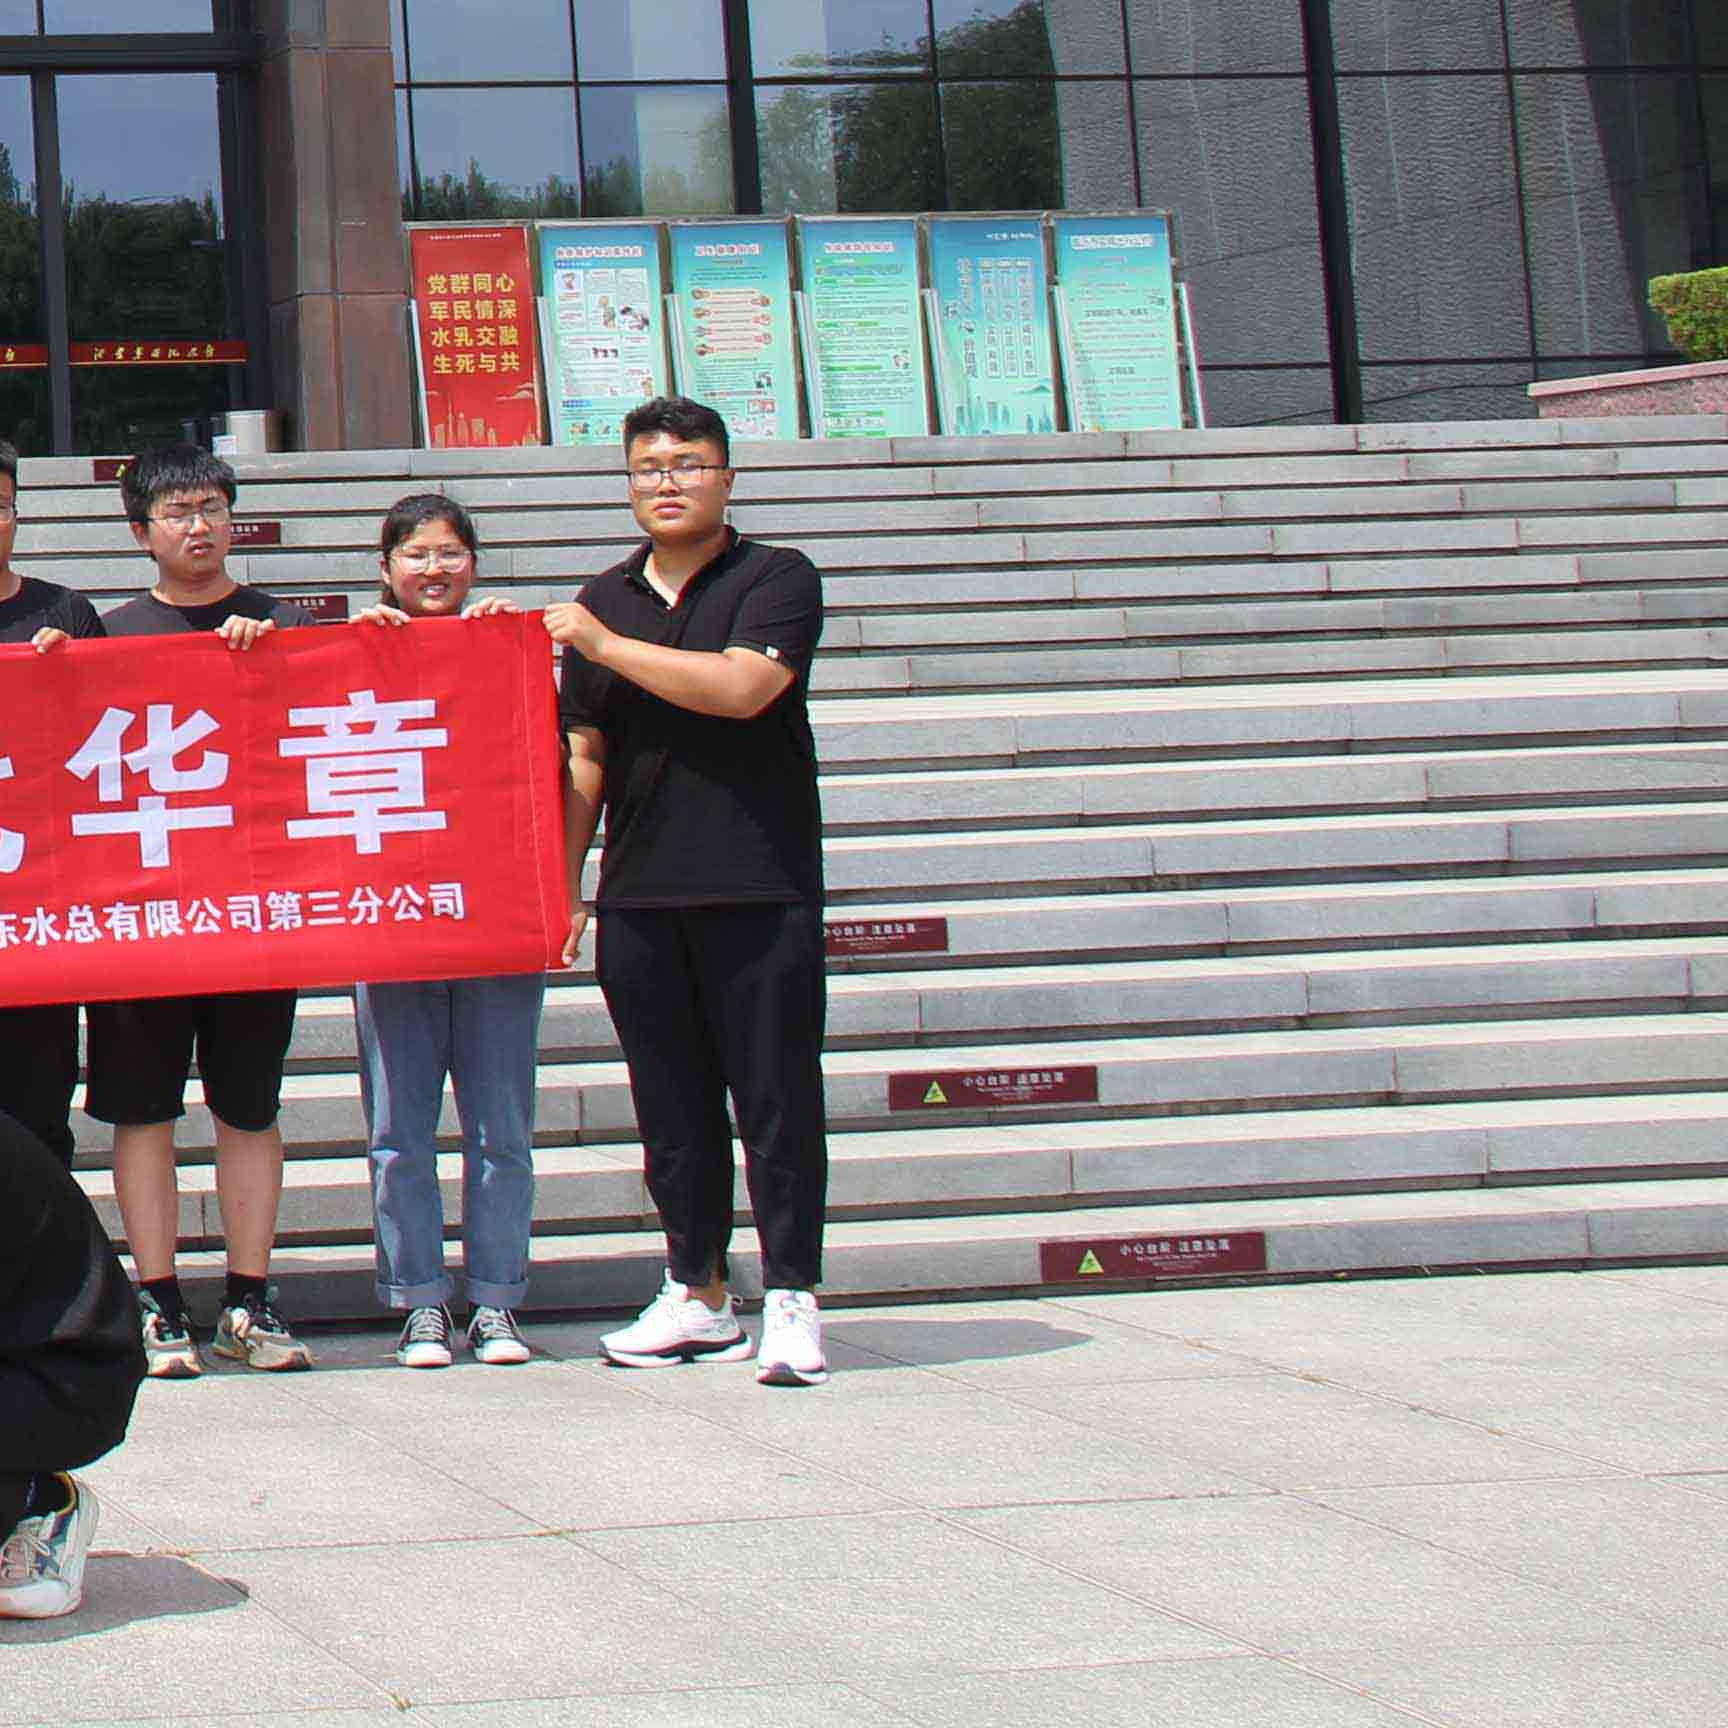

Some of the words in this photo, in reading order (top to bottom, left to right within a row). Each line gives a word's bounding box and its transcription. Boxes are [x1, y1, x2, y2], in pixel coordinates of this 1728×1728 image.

[427, 273, 515, 295] 党群同心
[429, 298, 518, 321] 军民情深
[431, 325, 519, 348] 水乳交融
[433, 351, 521, 374] 生死与共
